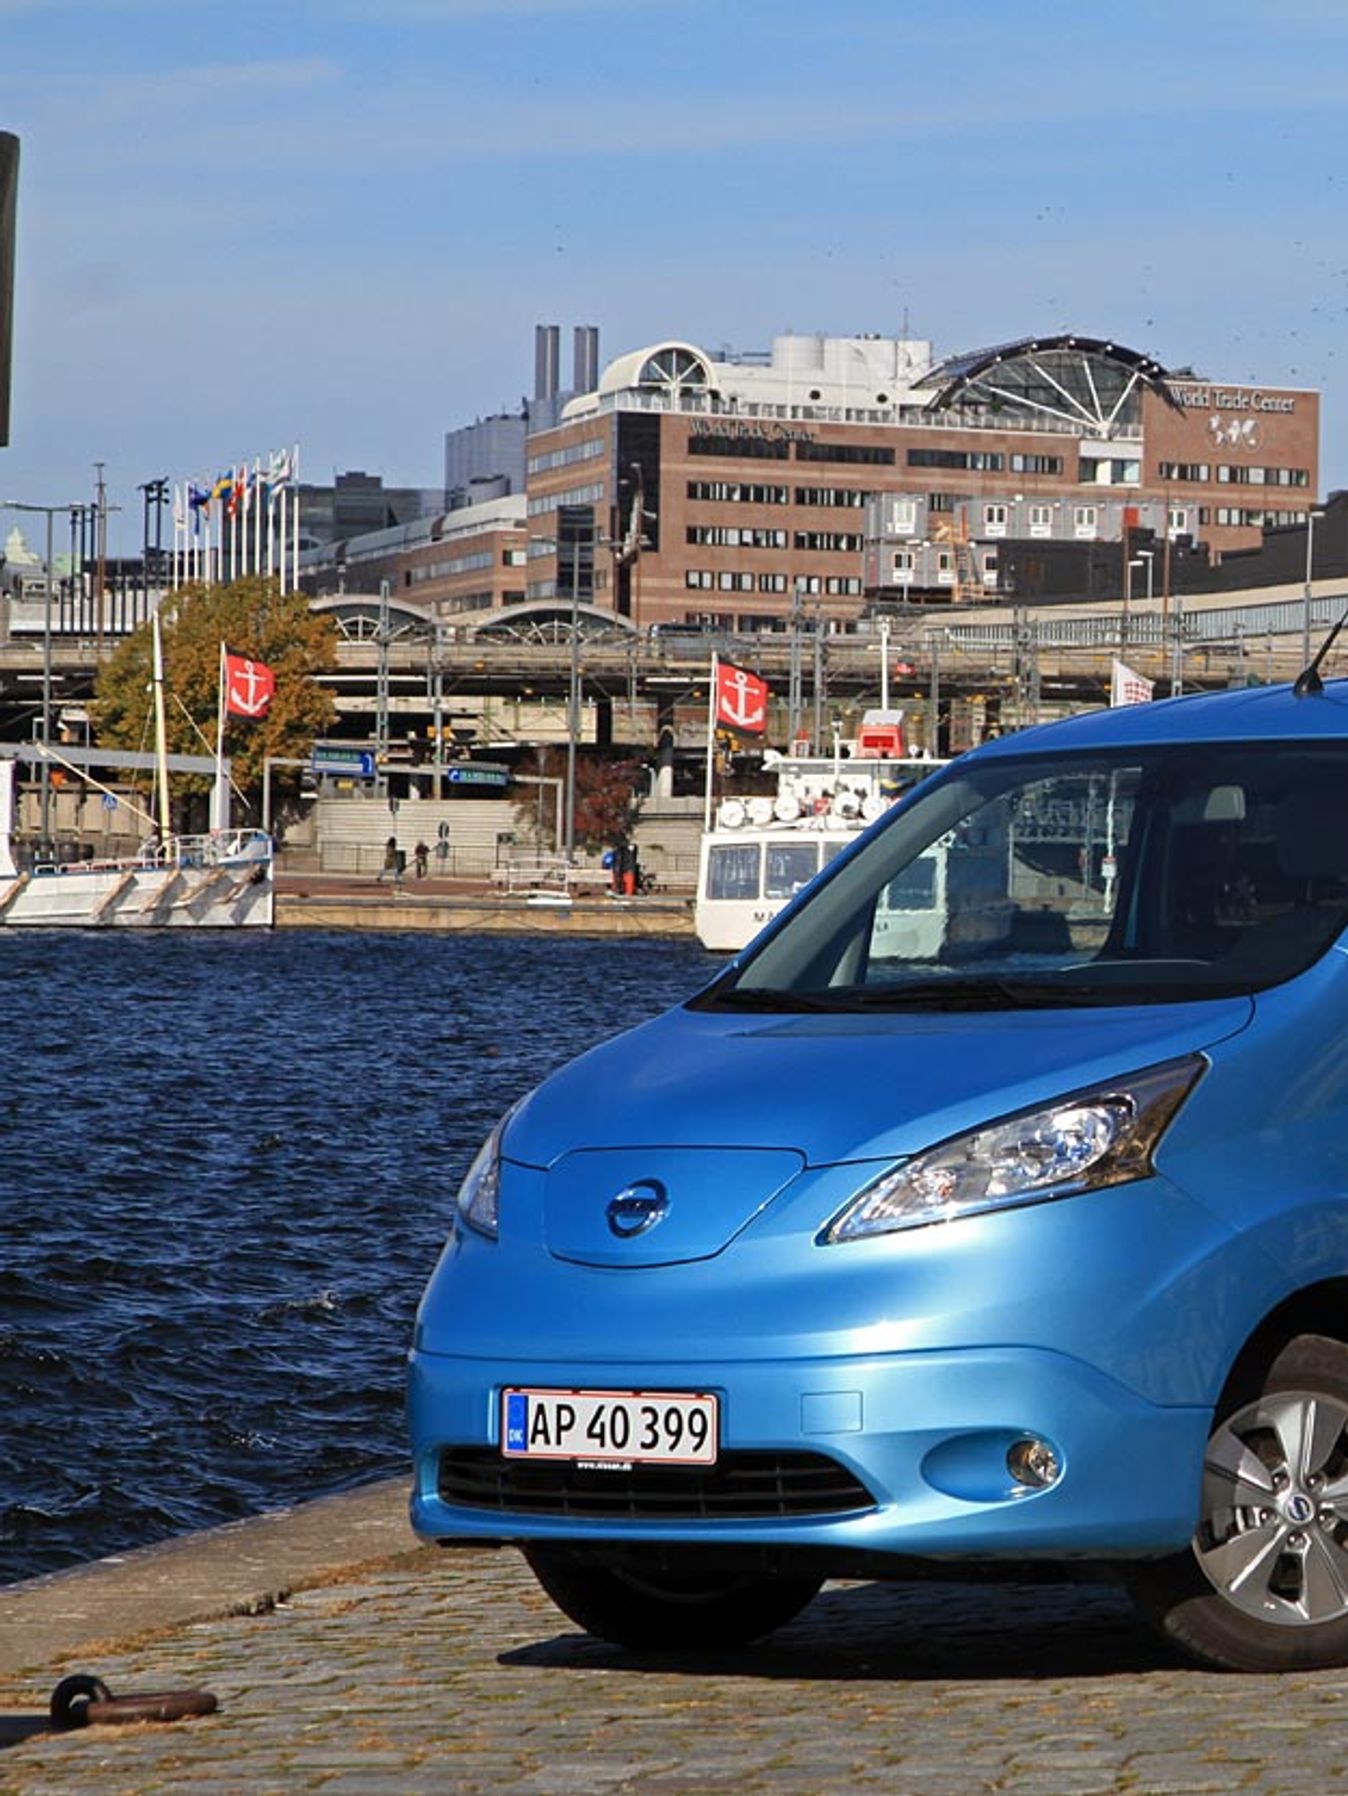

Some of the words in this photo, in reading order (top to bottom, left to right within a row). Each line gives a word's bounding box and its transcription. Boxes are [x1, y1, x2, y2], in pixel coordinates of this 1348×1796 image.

[1170, 386, 1209, 409] World
[1214, 389, 1249, 410] Trade
[1250, 390, 1295, 413] Center
[530, 1403, 575, 1446] AP
[587, 1404, 630, 1449] 40
[640, 1406, 708, 1452] 399
